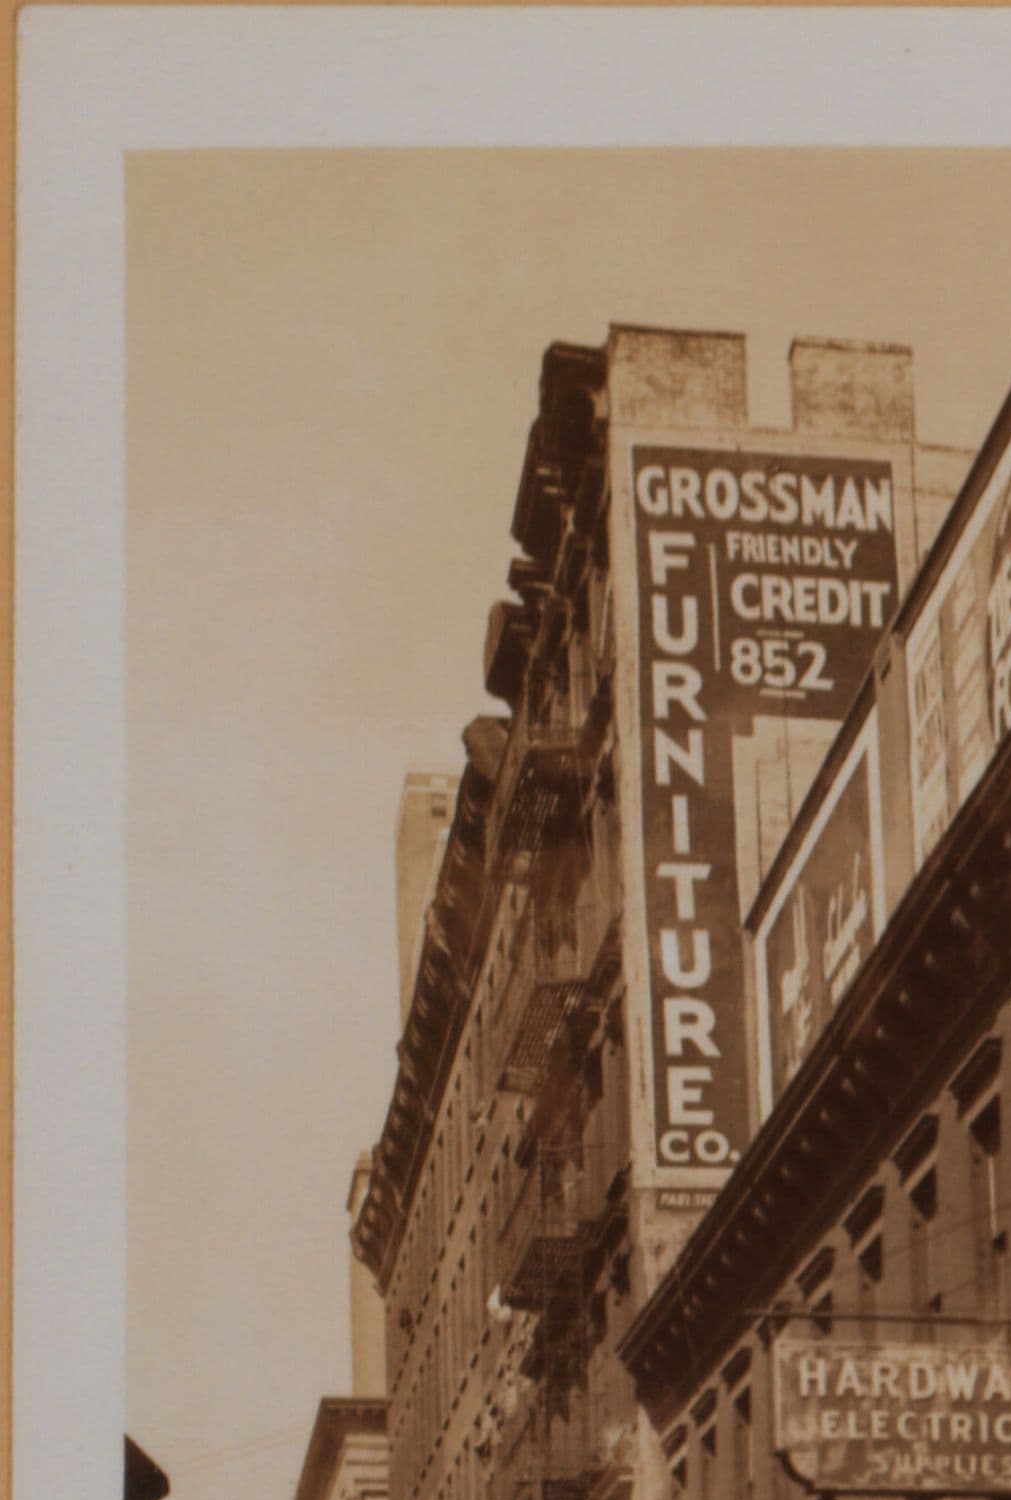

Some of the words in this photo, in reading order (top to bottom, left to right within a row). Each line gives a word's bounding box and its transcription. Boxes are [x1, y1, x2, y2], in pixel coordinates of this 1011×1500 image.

[636, 465, 892, 531] GROSSMAN
[725, 531, 859, 570] FRIENDLY
[730, 573, 891, 628] CREDIT
[730, 638, 834, 691] 852
[648, 531, 721, 1126] FURNITURE
[659, 1132, 741, 1163] CO.
